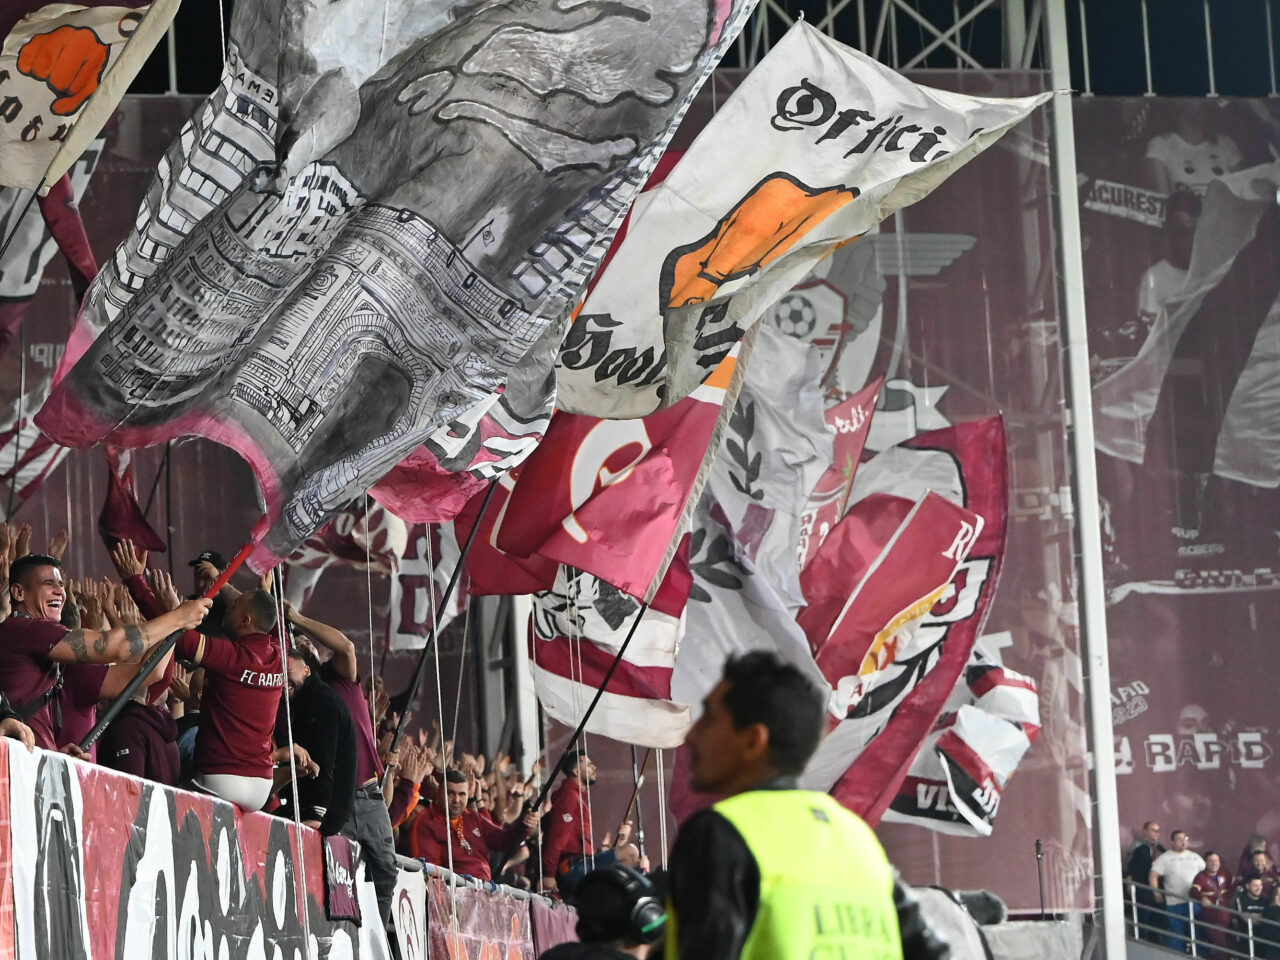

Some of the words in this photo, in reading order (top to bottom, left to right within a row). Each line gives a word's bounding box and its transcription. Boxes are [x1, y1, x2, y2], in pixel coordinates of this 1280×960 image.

[240, 669, 258, 685] FC
[1110, 680, 1150, 705] APID
[1144, 738, 1273, 769] RAPID
